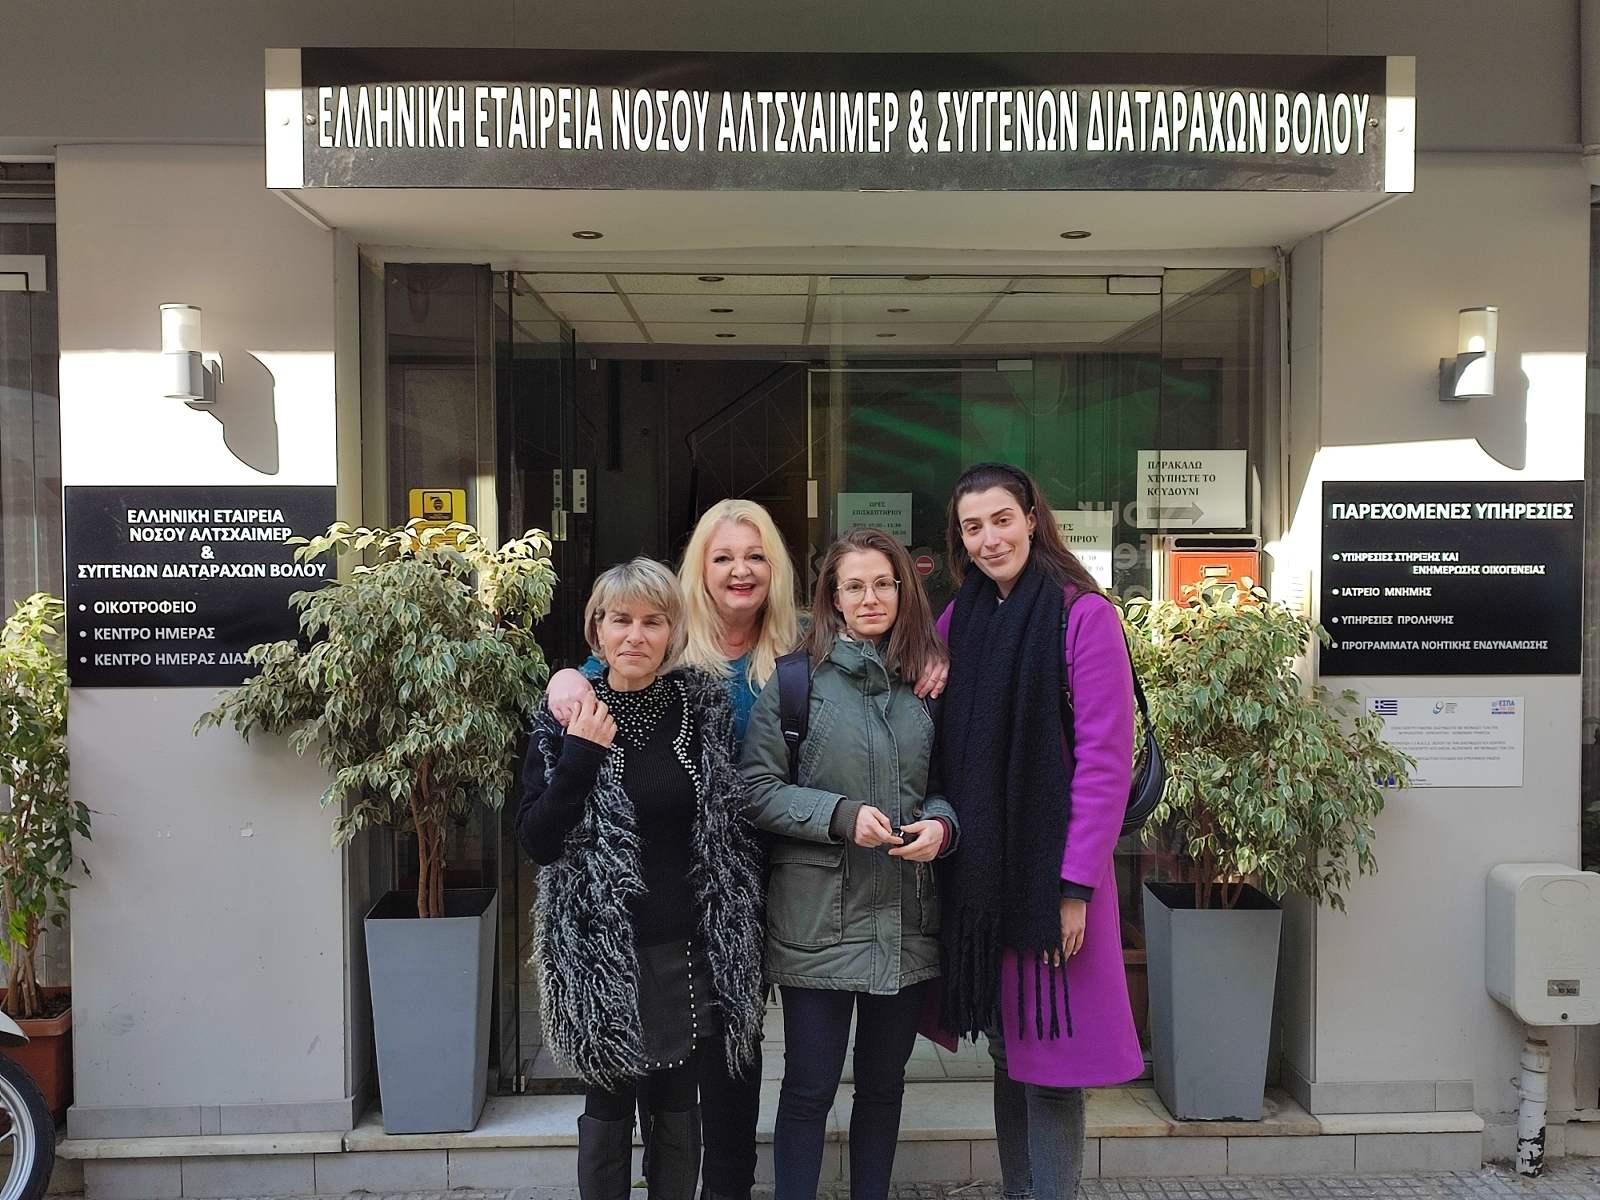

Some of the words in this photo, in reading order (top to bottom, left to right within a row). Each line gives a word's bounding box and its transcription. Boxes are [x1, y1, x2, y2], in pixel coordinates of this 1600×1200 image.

[318, 86, 465, 148] ΕΛΛΗΝΙΚΗ
[475, 87, 604, 150] ΕΤΑΙΡΕΙΑ
[612, 89, 710, 152] ΝΟΣΟΥ
[718, 91, 900, 153] ΑΛΤΣΧΑΙΜΕΡ
[908, 90, 928, 154] &
[937, 91, 1078, 152] ΣΥΓΓΕΝΩΝ
[1086, 91, 1267, 153] ΔΙΑΤΑΡΑΧΩΝ
[1275, 93, 1370, 154] ΒΟΛΟΥ
[1147, 460, 1202, 470] ΠΑΡΑΚΑΛΩ
[1147, 474, 1200, 483] ΧΤΥΠΗΣΤΕ
[1202, 474, 1216, 482] ΤΟ
[1147, 487, 1199, 496] ΚΟΥΔΟΥΝΙ
[127, 509, 210, 523] ΕΛΛΗΝΙΚΗ
[213, 509, 285, 523] ΕΤΑΙΡΕΙΑ
[1332, 503, 1472, 520] ΠΑΡΕΧΟΜΕΝΕΣ
[1474, 503, 1574, 520] ΥΠΗΡΕΣΙΕΣ
[129, 527, 186, 542] ΝΟΣΟΥ
[189, 527, 293, 542] ΑΛΤΣΧΑΙΜΕΡ
[200, 545, 215, 560] &
[1340, 552, 1394, 562] ΥΠΗΡΕΣΙΕΣ
[1441, 552, 1459, 562] ΚΑΙ
[77, 564, 158, 579] ΣΥΓΓΕΝΩΝ
[161, 564, 266, 578] ΔΙΑΤΑΡΑΧΩΝ
[269, 563, 327, 578] ΒΟΛΟΥ
[1412, 565, 1481, 575] ΕΝΗΜΕΡΩΣΗΣ
[1481, 564, 1546, 575] ΟΙΚΟΓΕΝΕΙΑΣ
[1341, 587, 1381, 597] ΙΑΤΡΕΙΟ
[1384, 587, 1432, 597] ΜΝΗΜΗΣ
[93, 600, 197, 614] ΟΙΚΟΤΡΟΦΕΙΟ
[1341, 615, 1394, 625] ΥΠΗΡΕΣΙΕΣ
[1397, 615, 1454, 625] ΠΡΟΛΗΨΗΣ
[94, 628, 151, 641] ΚΕΝΤΡΟ
[155, 627, 216, 640] ΗΜΕΡΑΣ
[1341, 640, 1420, 650] ΠΡΟΓΡΑΜΜΑΤΑ
[1421, 640, 1471, 650] ΝΟΗΤΙΚΗΣ
[1473, 640, 1548, 650] ΕΝΔΥΝΑΜΩΣΗΣ
[94, 654, 152, 666] ΚΕΝΤΡΟ
[155, 653, 216, 666] ΗΜΕΡΑΣ
